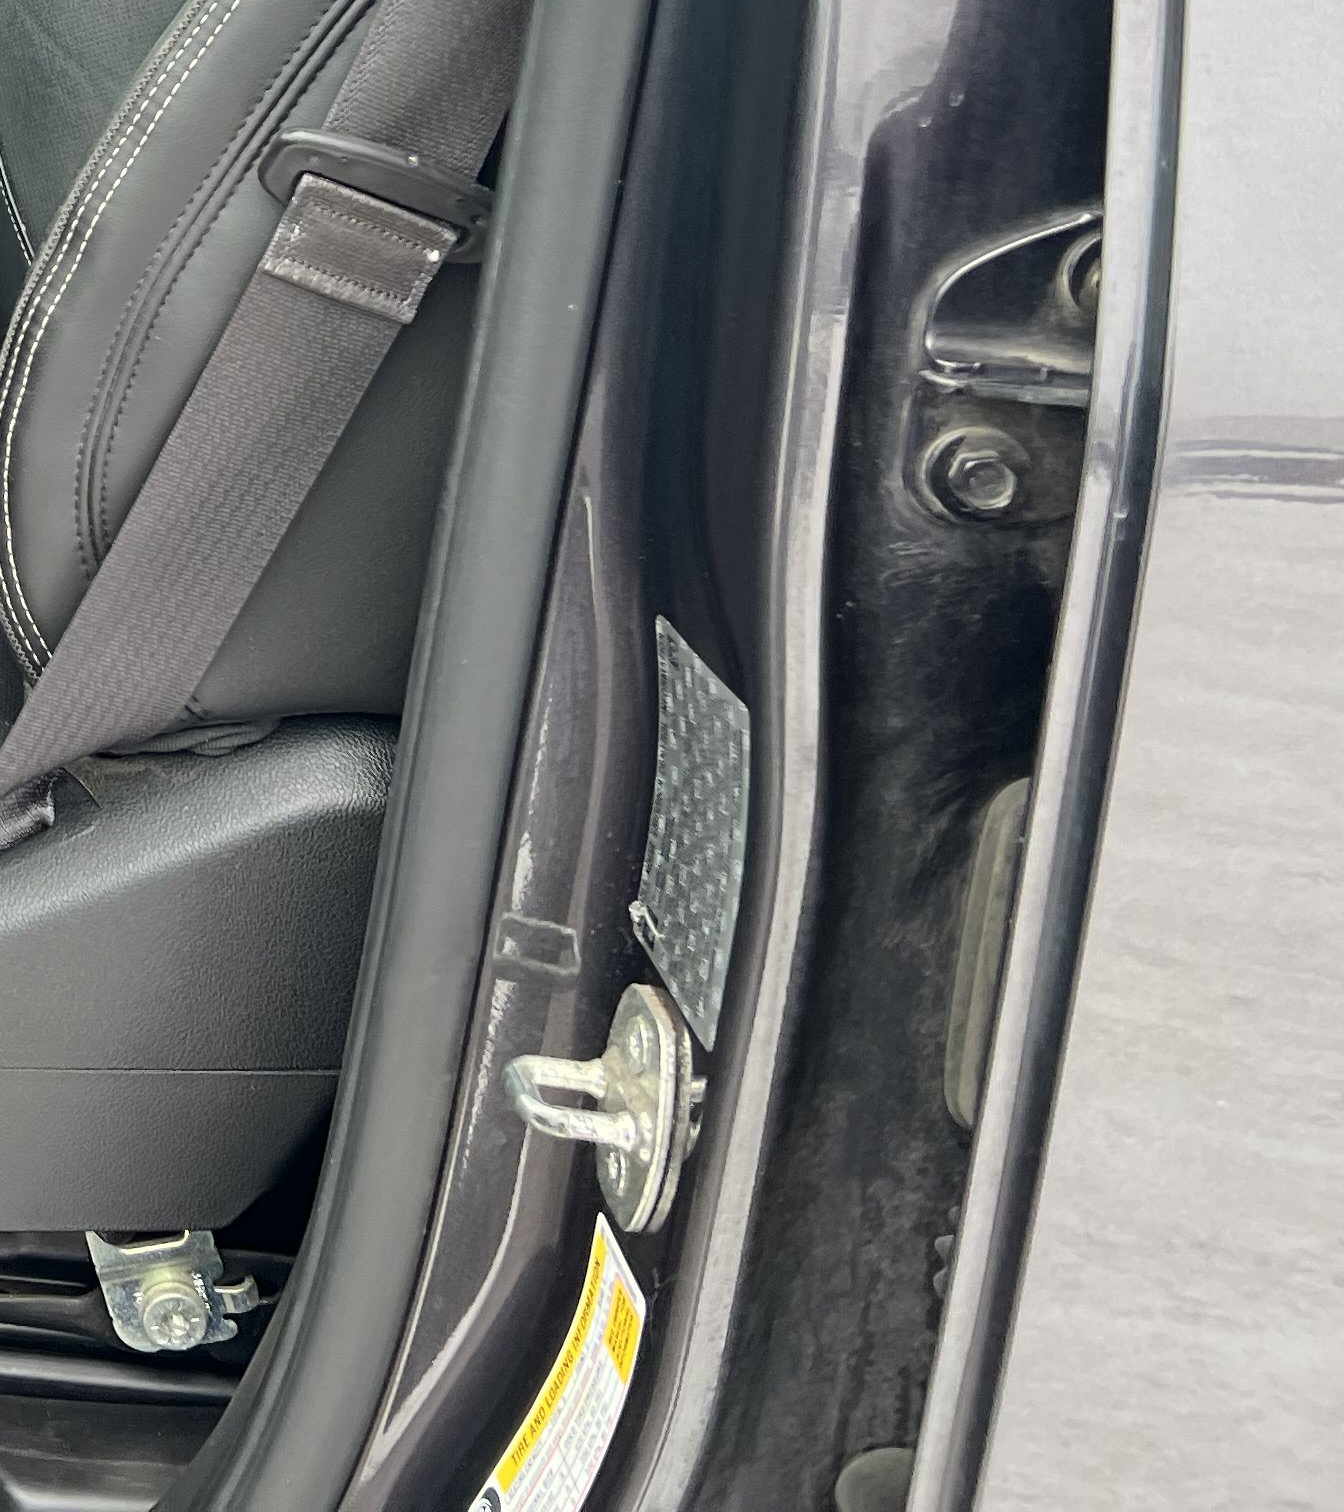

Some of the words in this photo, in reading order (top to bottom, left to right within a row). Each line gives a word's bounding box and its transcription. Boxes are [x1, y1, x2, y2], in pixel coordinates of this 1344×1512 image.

[511, 1433, 530, 1467] TIRE
[528, 1406, 546, 1437] AND
[544, 1349, 574, 1409] LOADING
[572, 1256, 601, 1352] INFORMATION
